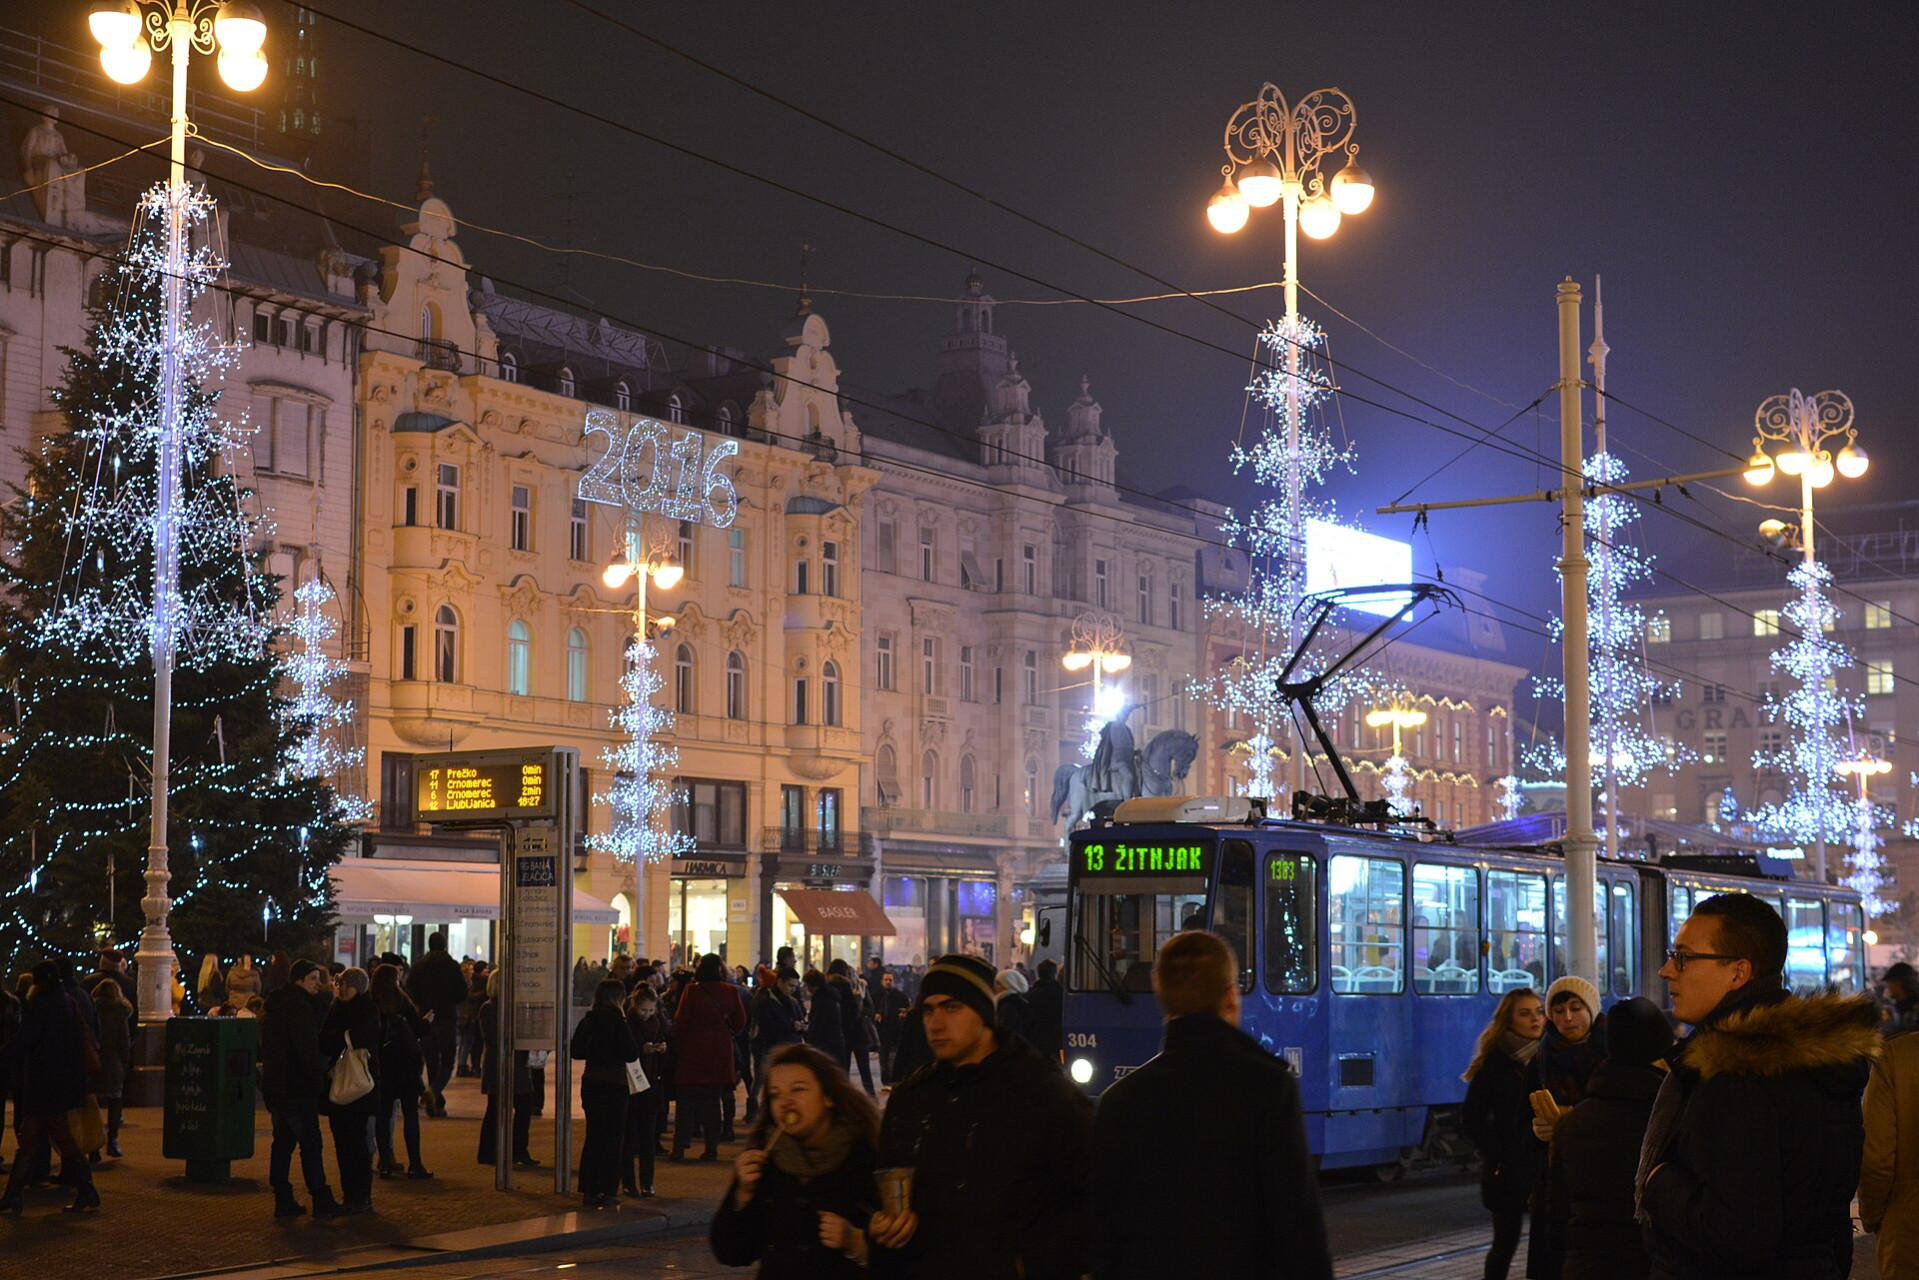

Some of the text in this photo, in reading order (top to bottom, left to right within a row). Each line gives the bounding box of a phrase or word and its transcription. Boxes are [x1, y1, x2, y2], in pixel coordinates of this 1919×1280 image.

[578, 409, 739, 529] 2016
[429, 764, 542, 780] 17 Prečko 0min
[429, 775, 542, 790] 11 Črnomerec 0min
[430, 785, 542, 800] 6 Črnomerec 2min
[428, 801, 439, 811] 12
[517, 796, 540, 807] 18:27
[530, 859, 551, 871] BANA
[1084, 843, 1203, 872] 13 ŽITNJAK
[685, 861, 727, 875] HARMICA
[817, 906, 859, 919] BASLER
[1068, 1032, 1098, 1049] 304
